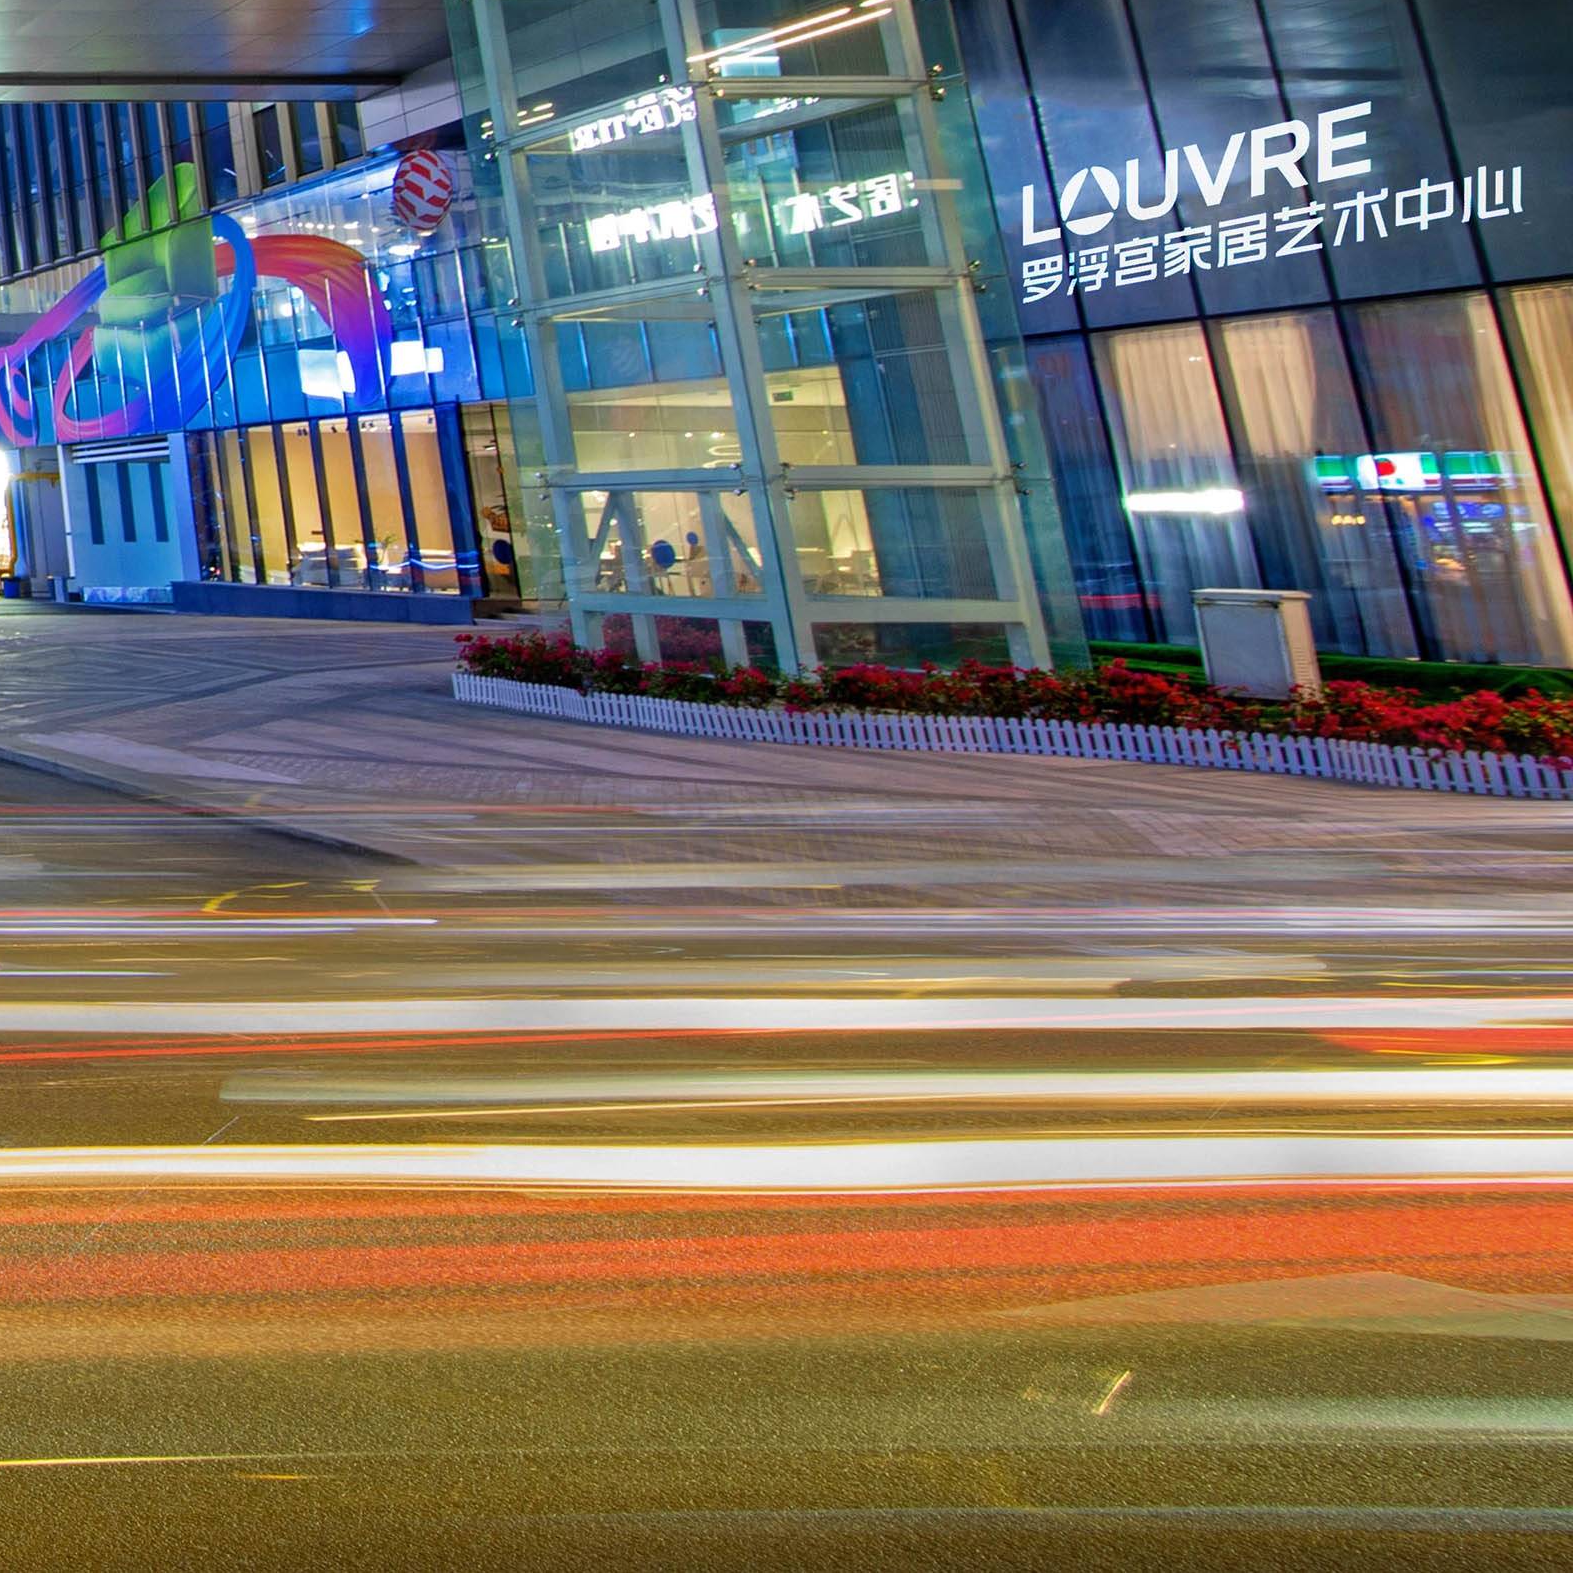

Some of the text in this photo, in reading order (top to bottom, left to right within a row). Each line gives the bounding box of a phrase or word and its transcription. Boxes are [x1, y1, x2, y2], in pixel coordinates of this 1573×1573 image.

[1021, 100, 1372, 246] LOUVRE
[1021, 165, 1523, 304] 罗浮宫家居艺术中心
